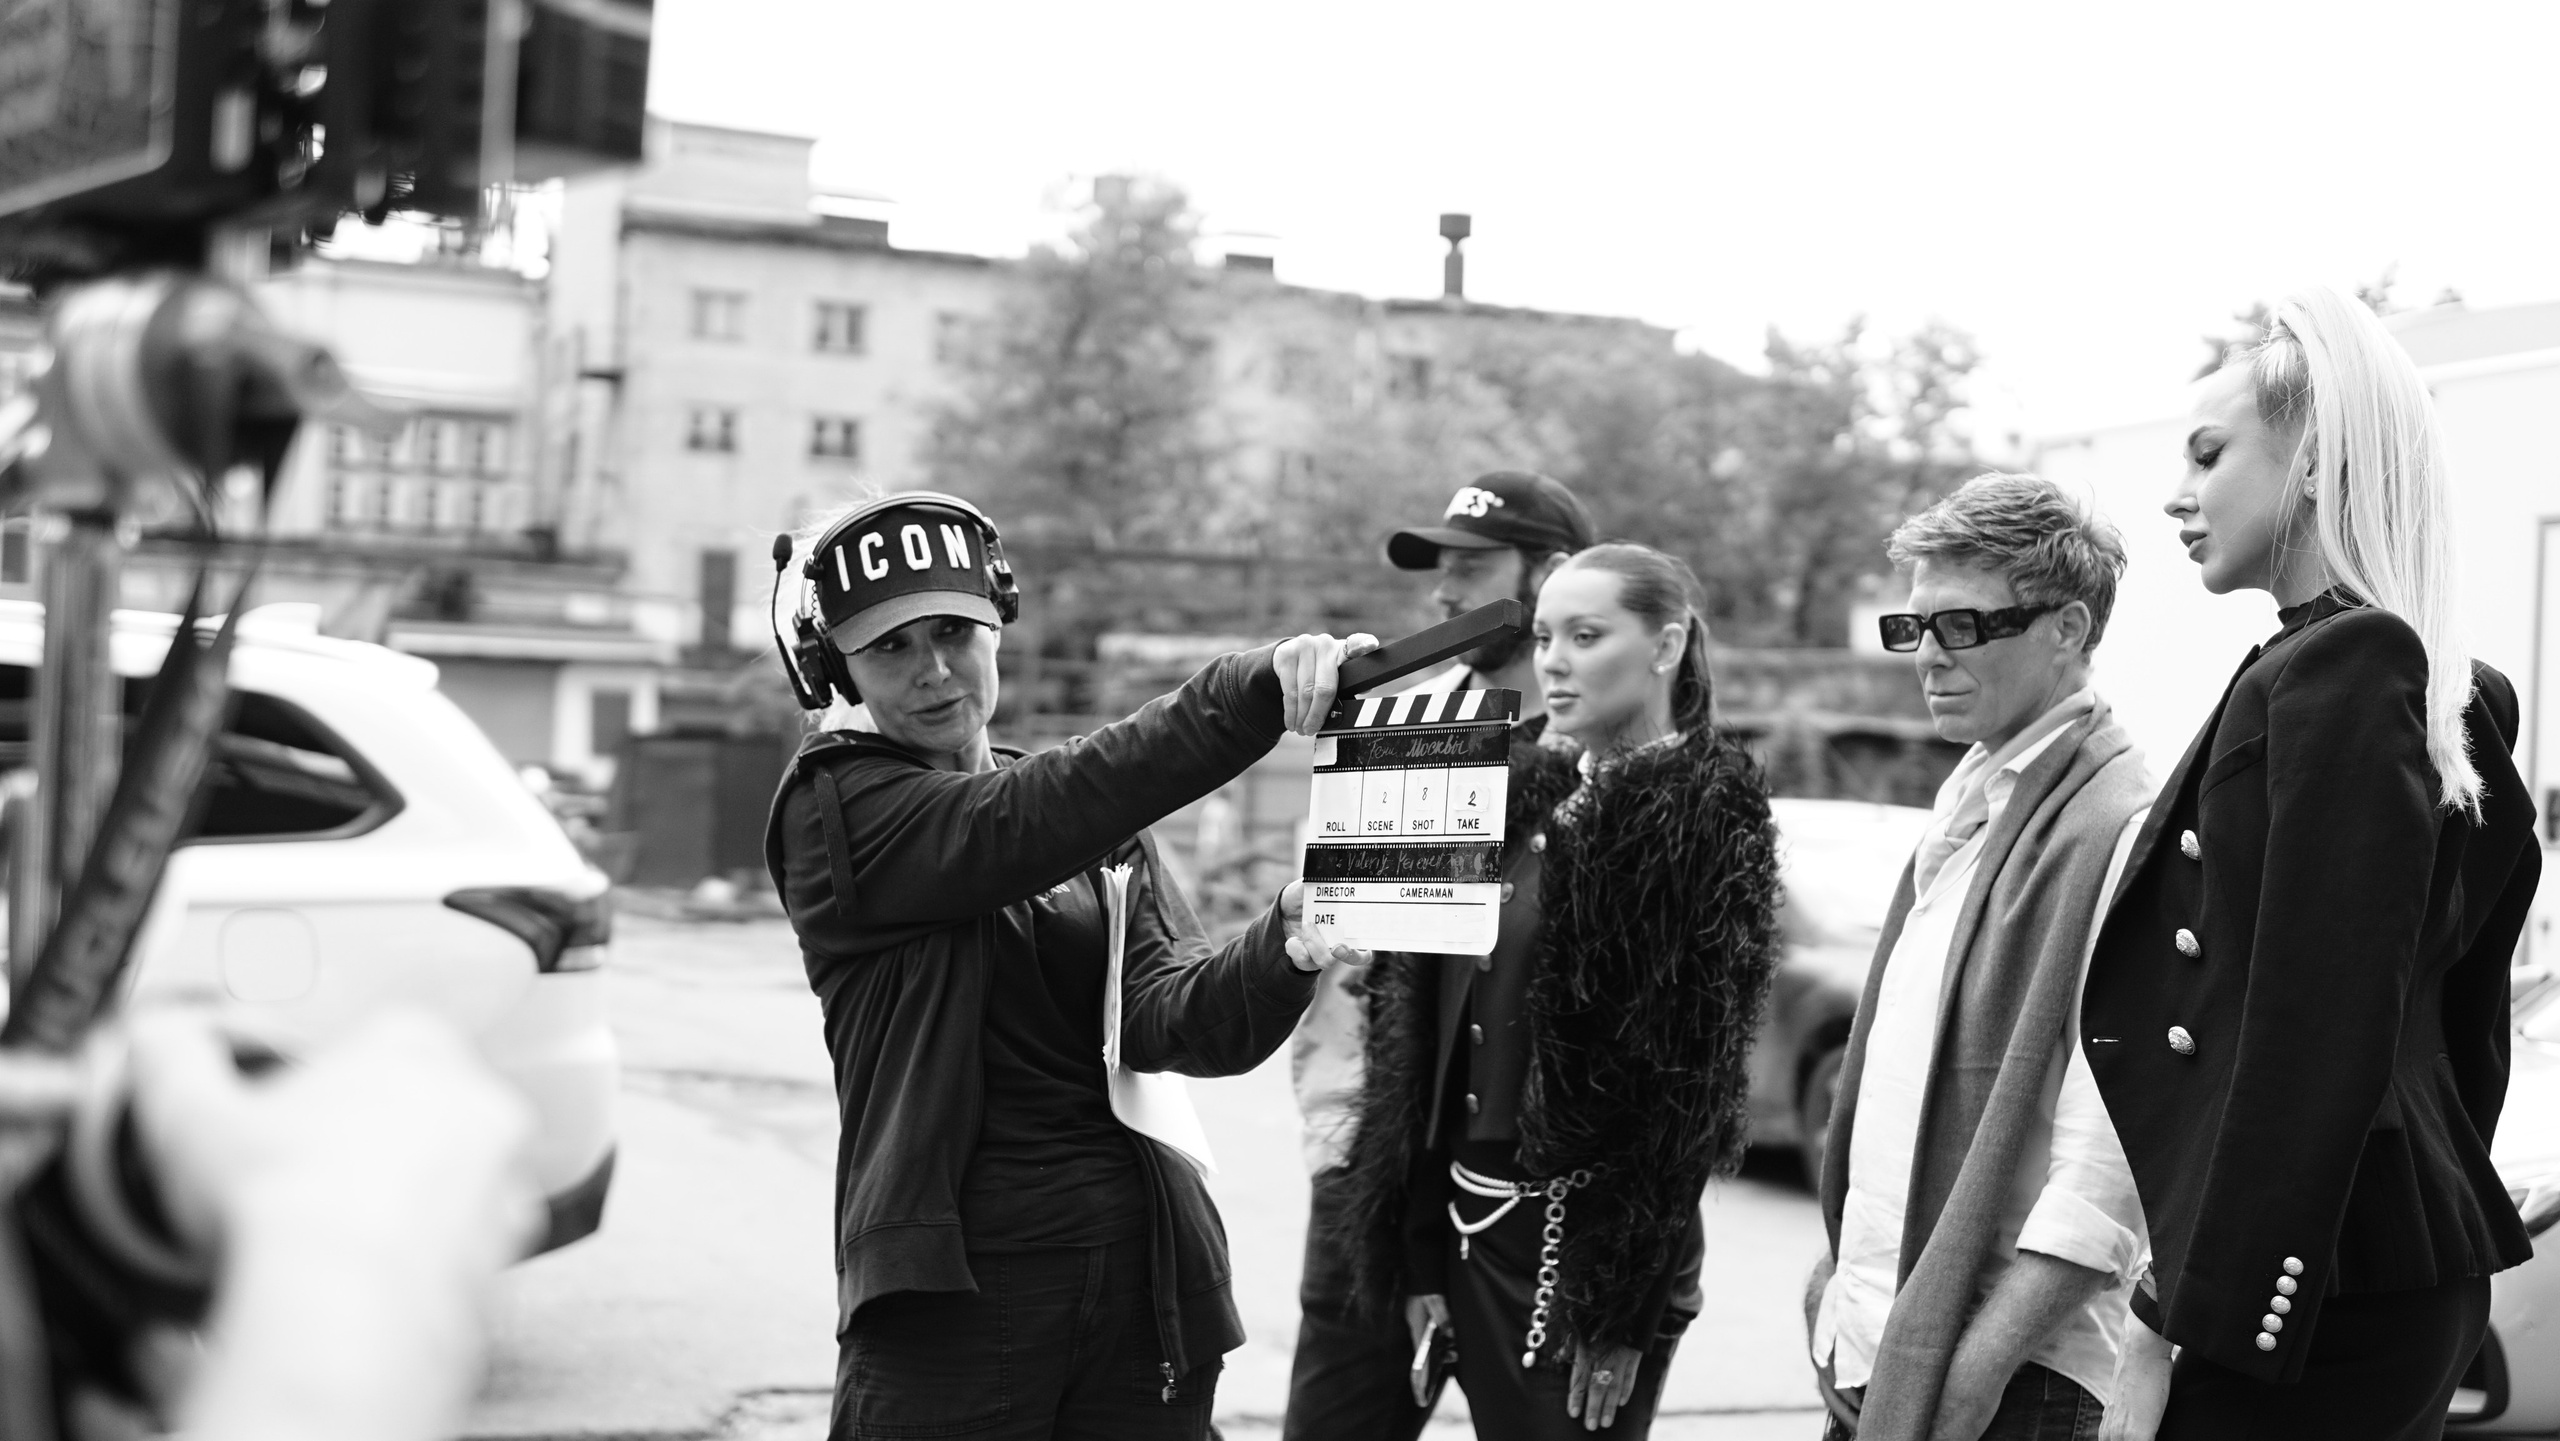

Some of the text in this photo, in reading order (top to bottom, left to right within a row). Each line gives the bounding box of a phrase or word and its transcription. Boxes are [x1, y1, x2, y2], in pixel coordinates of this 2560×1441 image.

[834, 523, 971, 592] ICON
[1382, 787, 1477, 807] 2 8 2
[1325, 818, 1480, 832] ROLL SCENE SHOT TAKE
[1316, 886, 1454, 899] DIRECTOR CAMERAMAN
[1314, 913, 1336, 925] DATE
